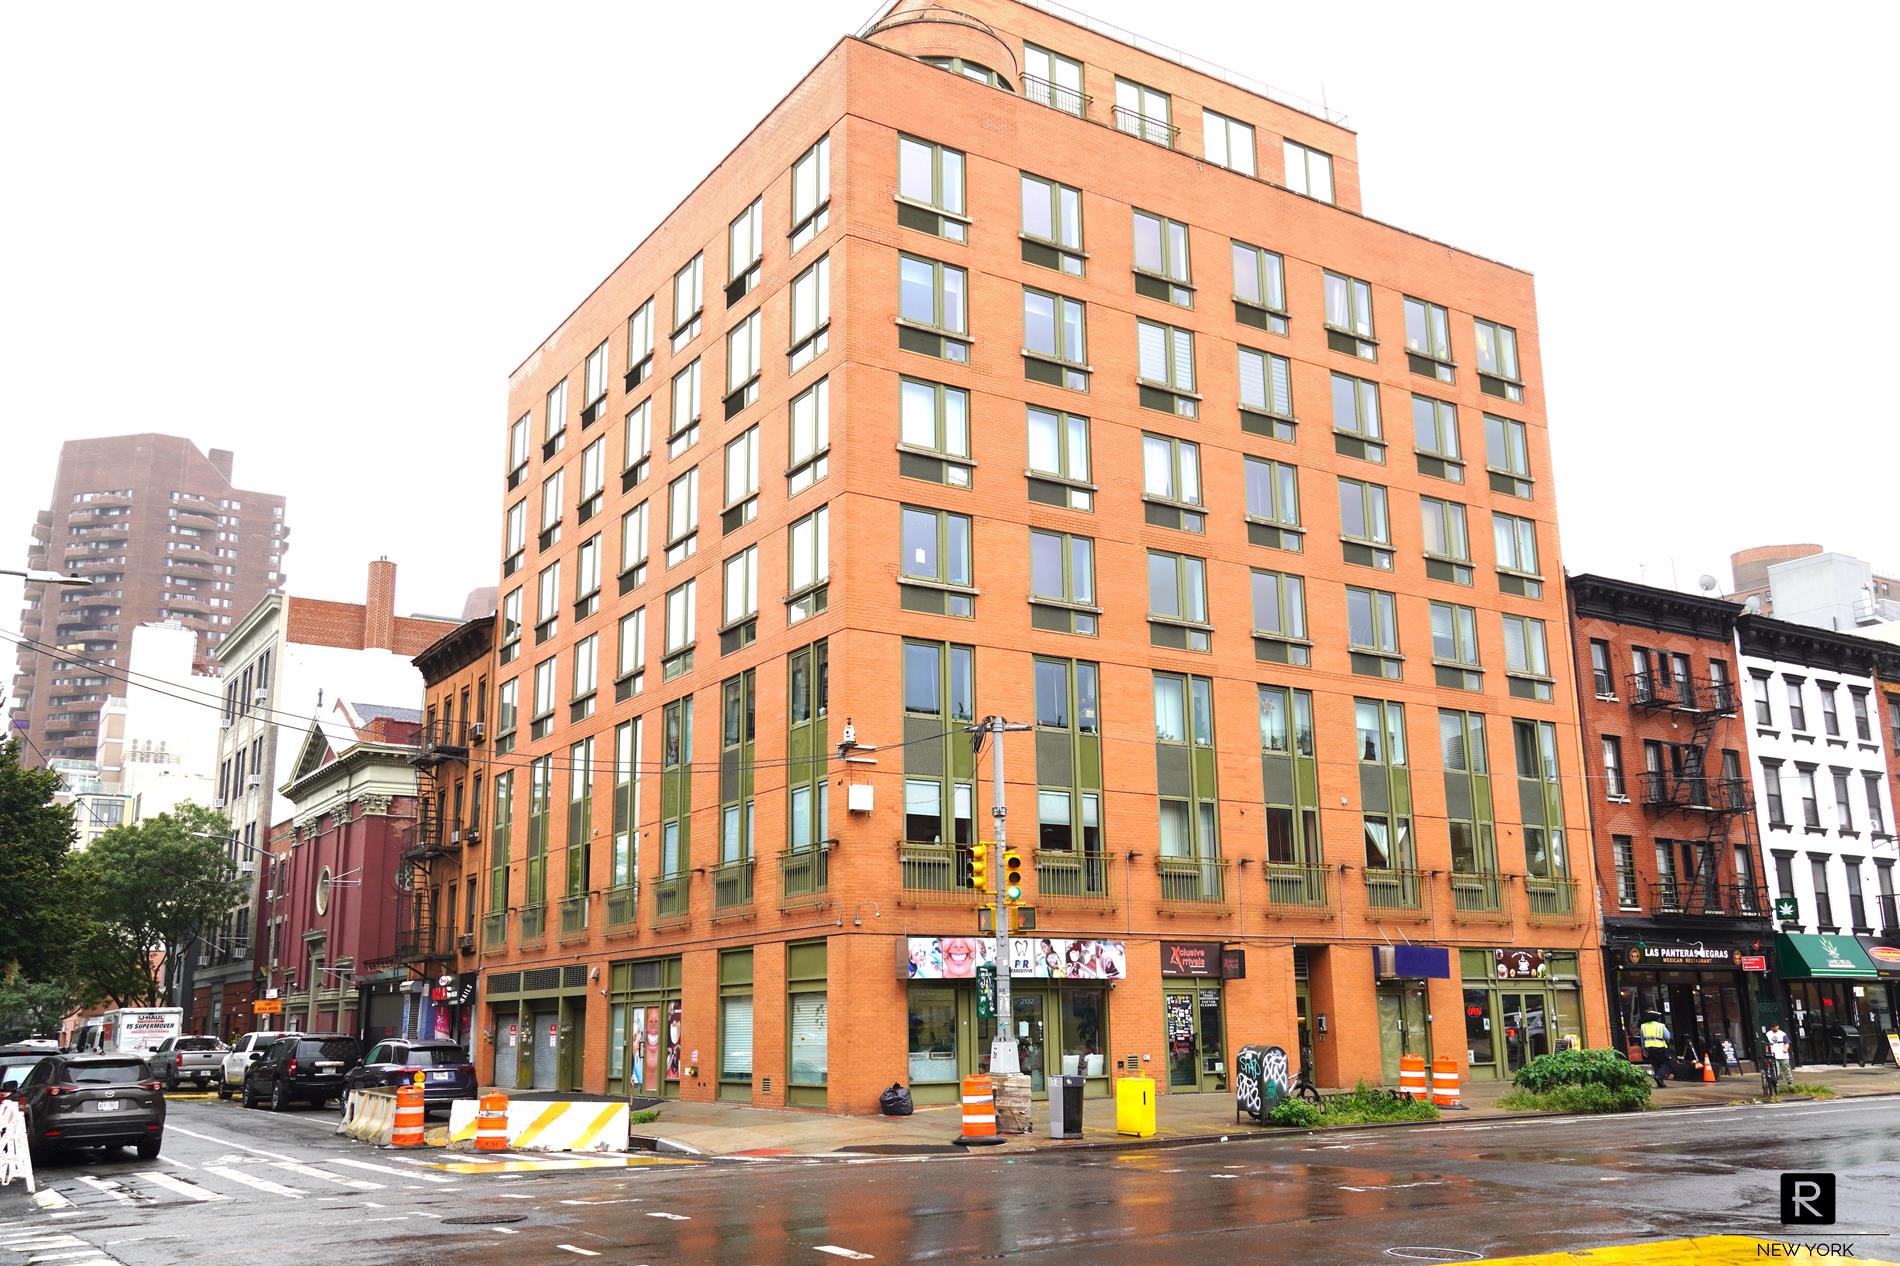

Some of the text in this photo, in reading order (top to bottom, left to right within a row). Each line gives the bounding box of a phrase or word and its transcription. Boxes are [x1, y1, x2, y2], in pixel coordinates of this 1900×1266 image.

[1644, 948, 1659, 957] LAS
[1661, 949, 1698, 958] PANTERAS
[459, 984, 473, 1004] NAILS
